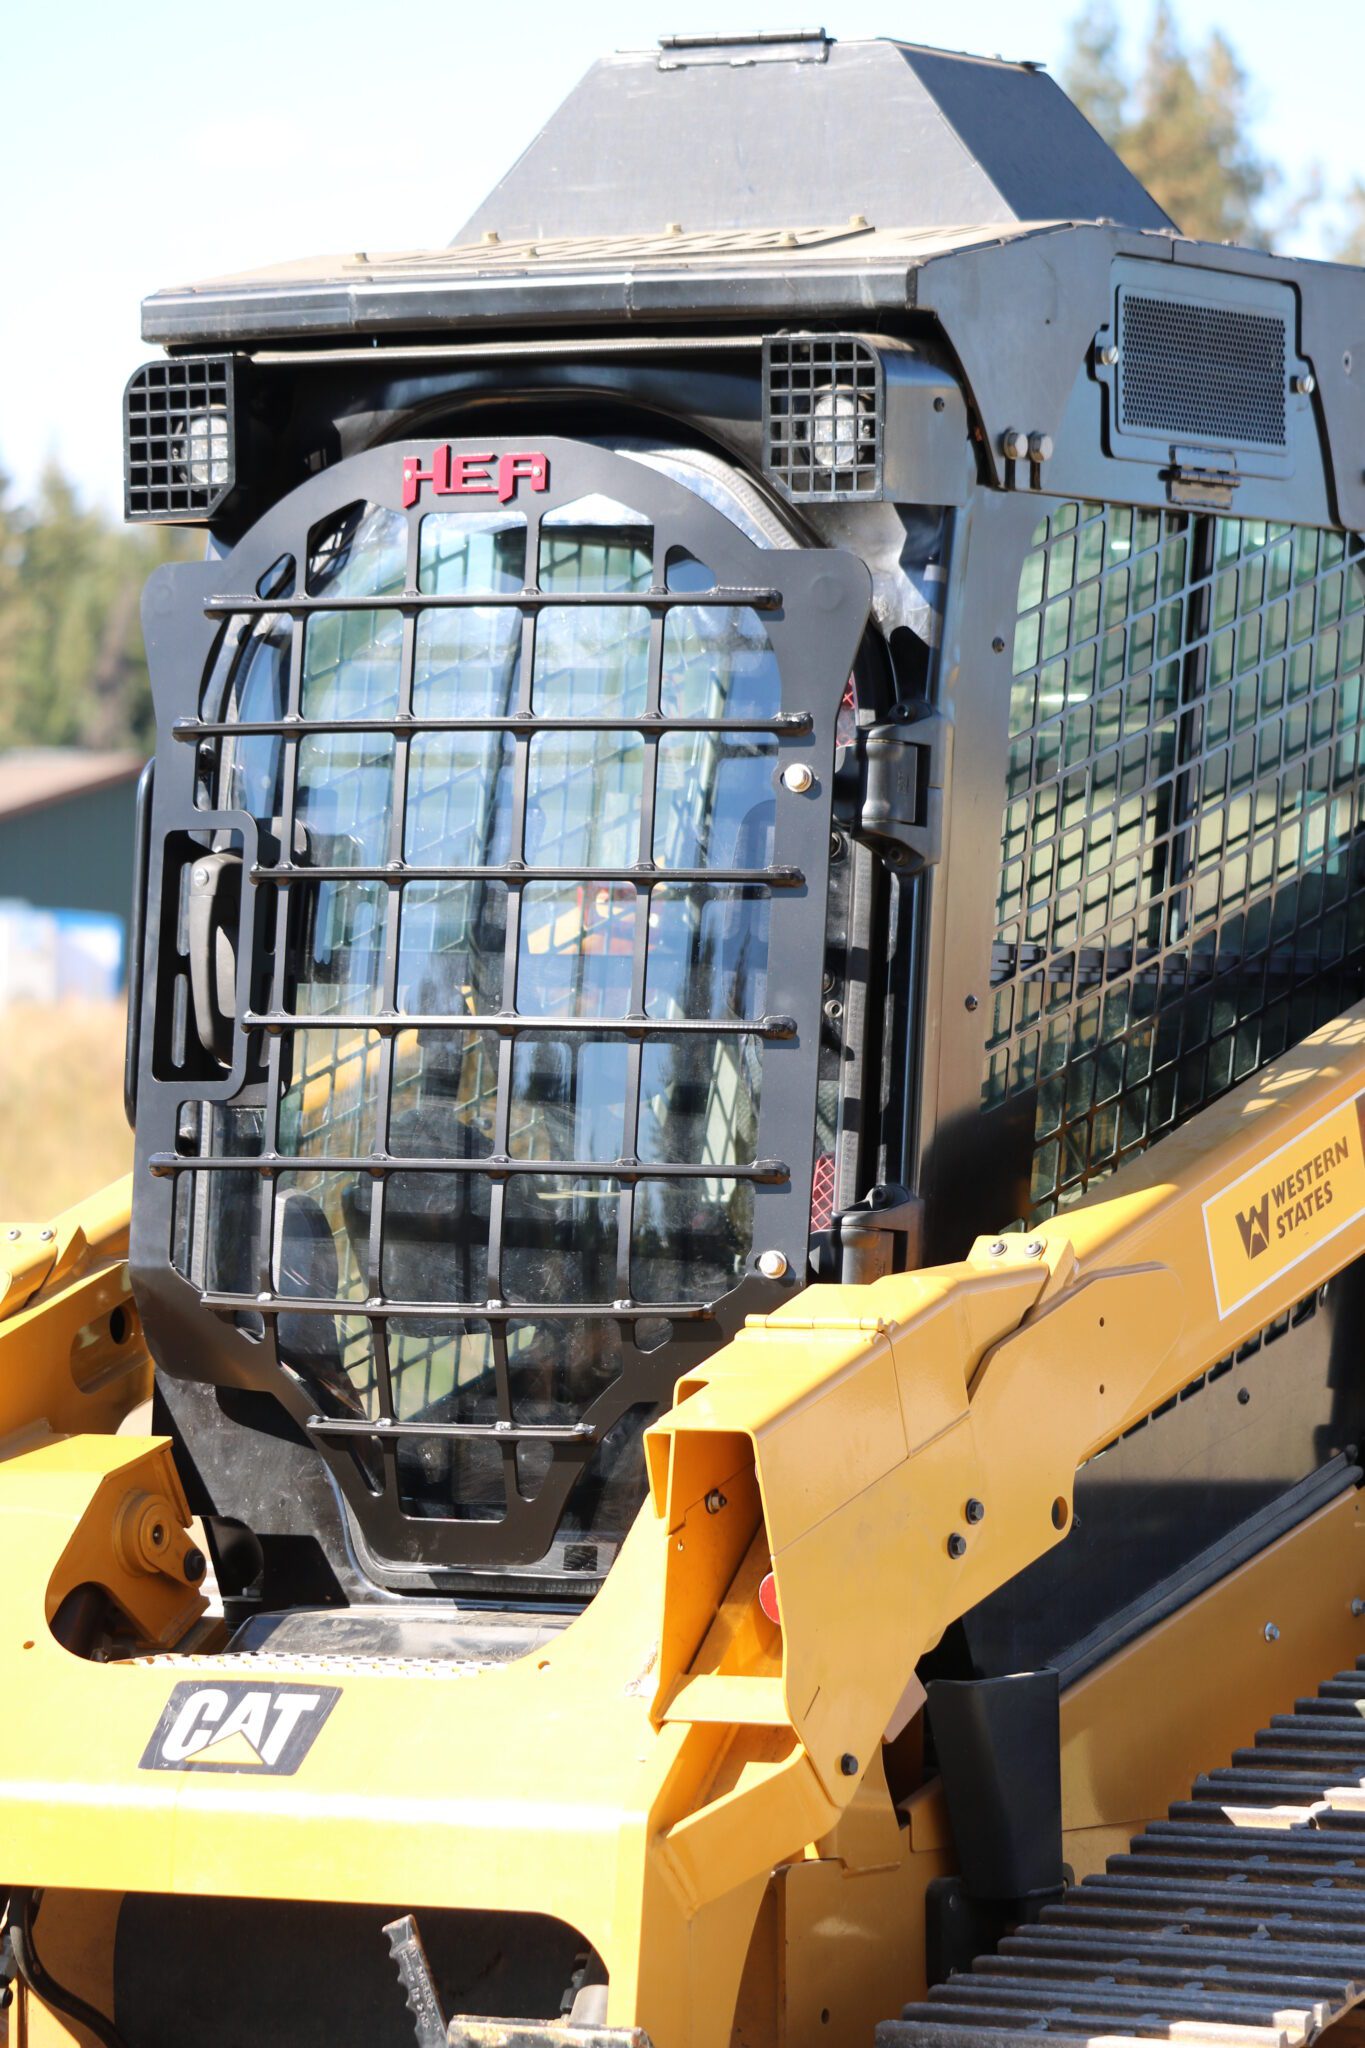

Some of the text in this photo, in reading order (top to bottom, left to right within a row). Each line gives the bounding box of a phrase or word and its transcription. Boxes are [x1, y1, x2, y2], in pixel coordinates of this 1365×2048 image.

[1271, 1136, 1349, 1208] WESTERN
[1276, 1180, 1333, 1239] STATES
[162, 1689, 320, 1765] CAT
